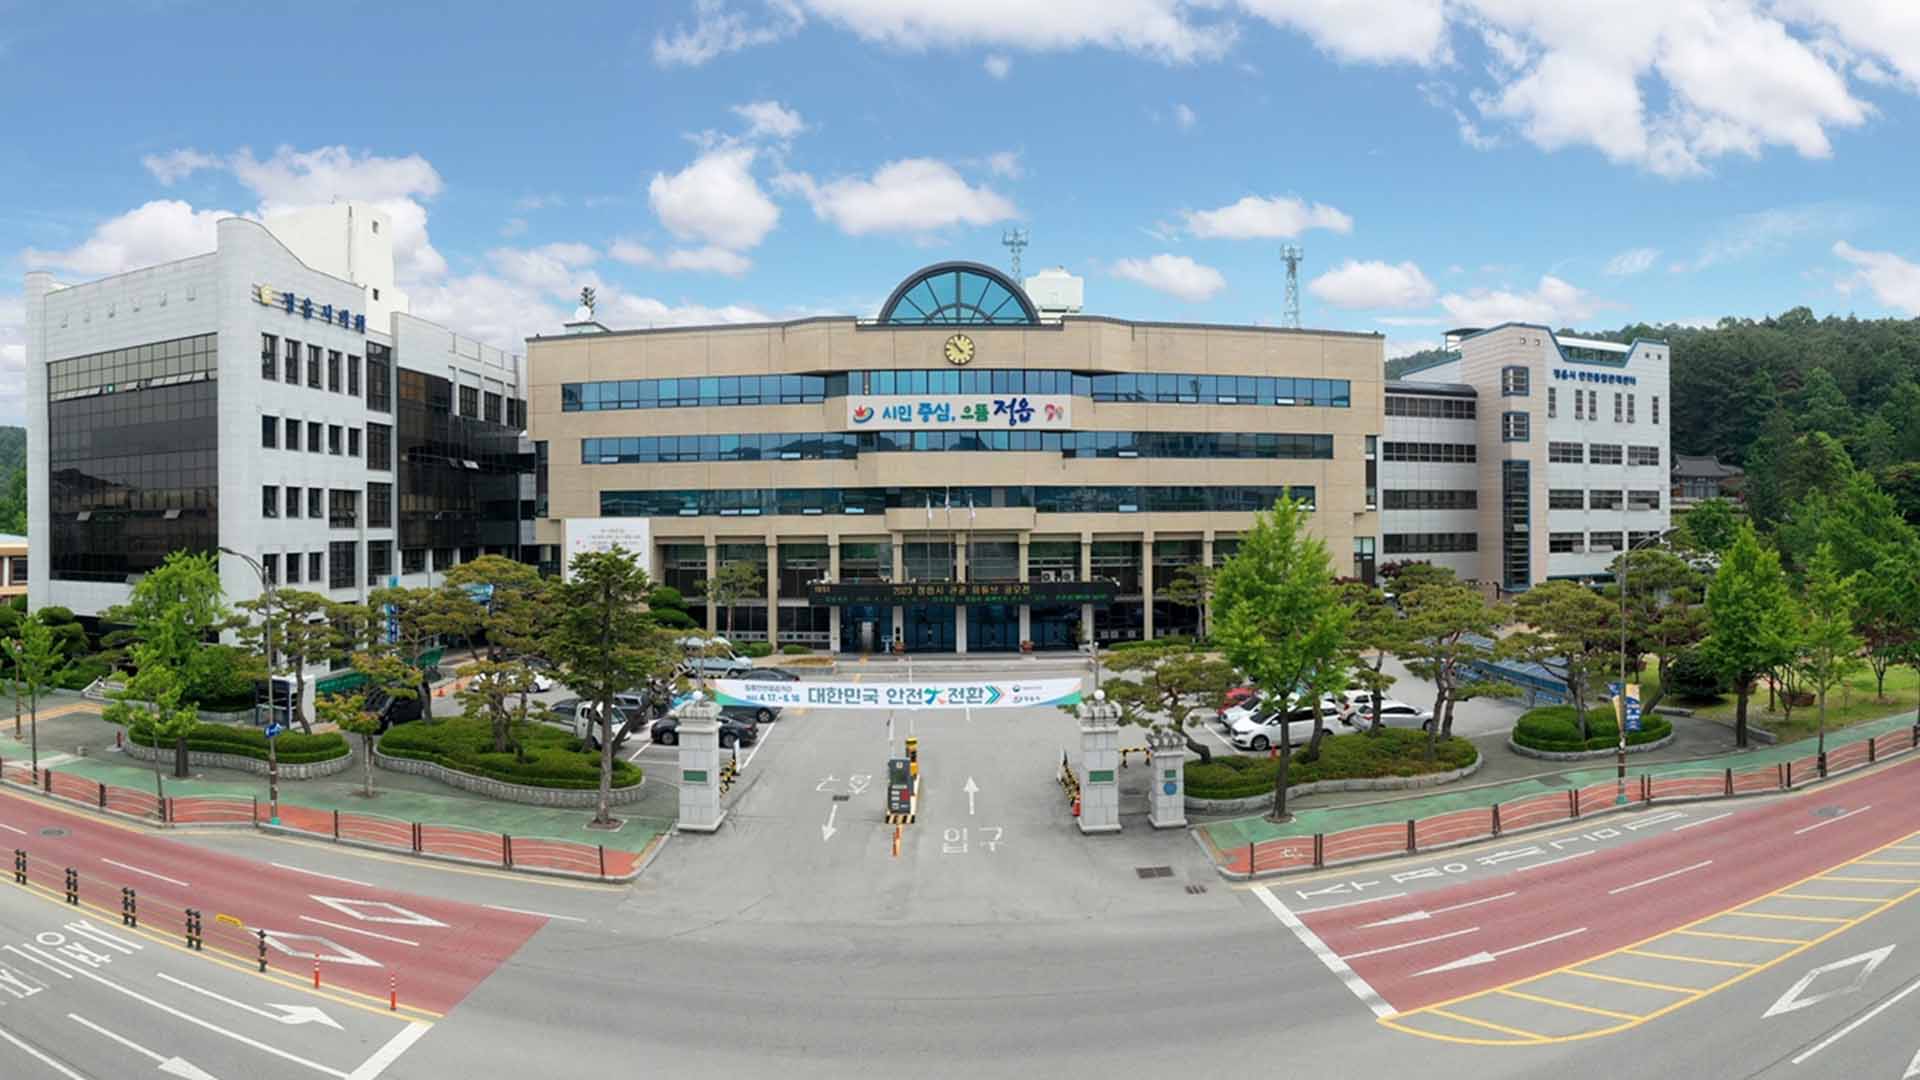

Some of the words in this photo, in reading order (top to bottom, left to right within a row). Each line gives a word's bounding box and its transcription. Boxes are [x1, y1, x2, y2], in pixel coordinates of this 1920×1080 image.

[882, 404, 912, 422] 시민
[917, 402, 956, 423] 중심,
[960, 403, 990, 422] 으뜸
[994, 397, 1035, 426] 정읍
[808, 687, 878, 704] 대한민국
[943, 827, 1006, 854] 입구
